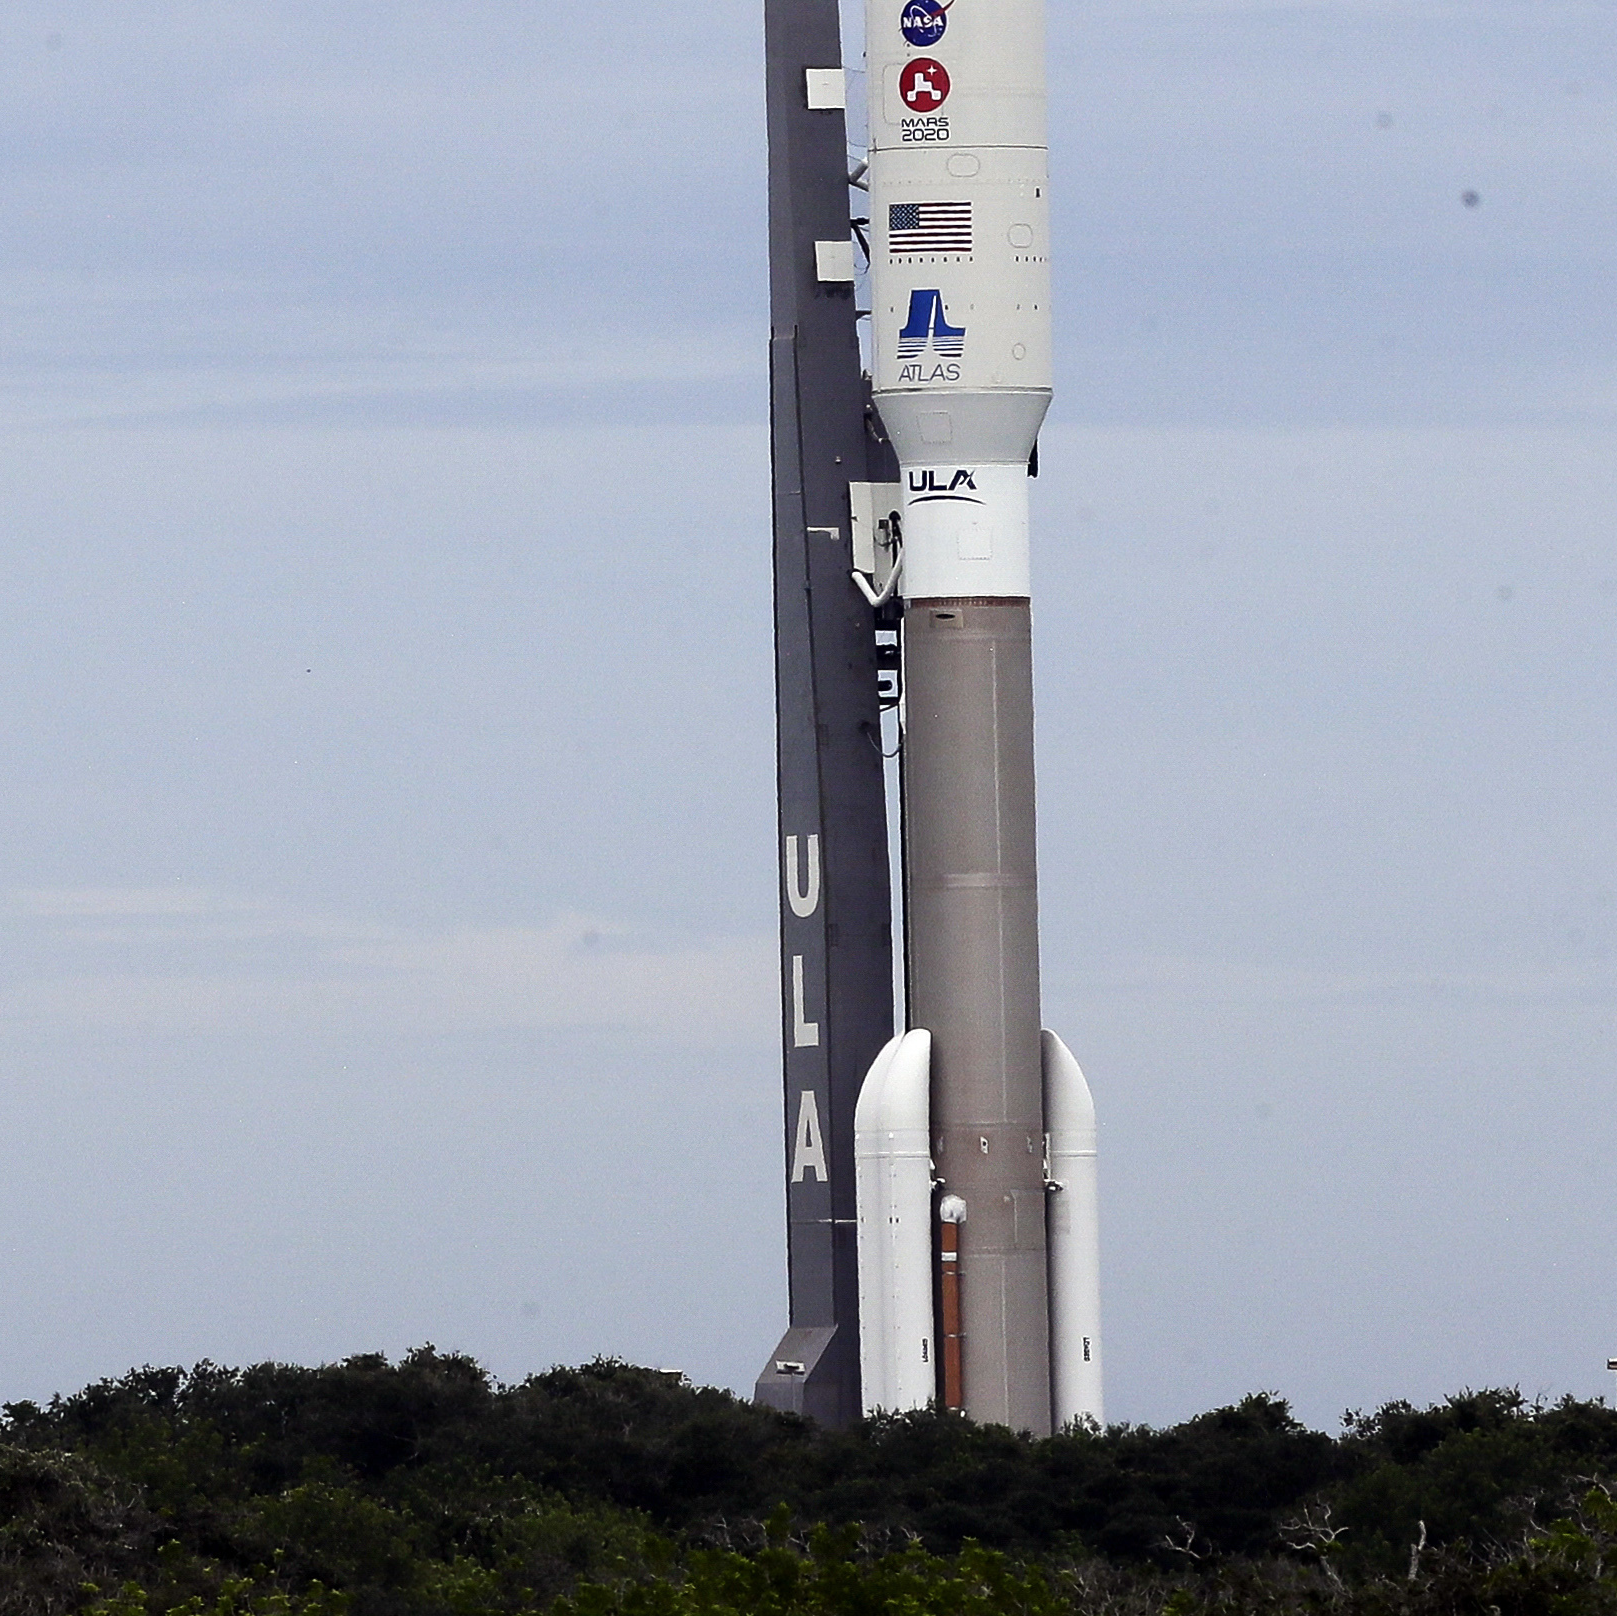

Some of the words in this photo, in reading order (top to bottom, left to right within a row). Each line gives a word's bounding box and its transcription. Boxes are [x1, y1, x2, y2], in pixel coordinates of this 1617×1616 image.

[903, 16, 944, 28] NASA
[901, 117, 949, 127] MARS
[902, 129, 950, 141] 2020
[898, 363, 961, 382] ATLAS
[908, 469, 977, 492] ULA
[786, 834, 828, 1183] ULA
